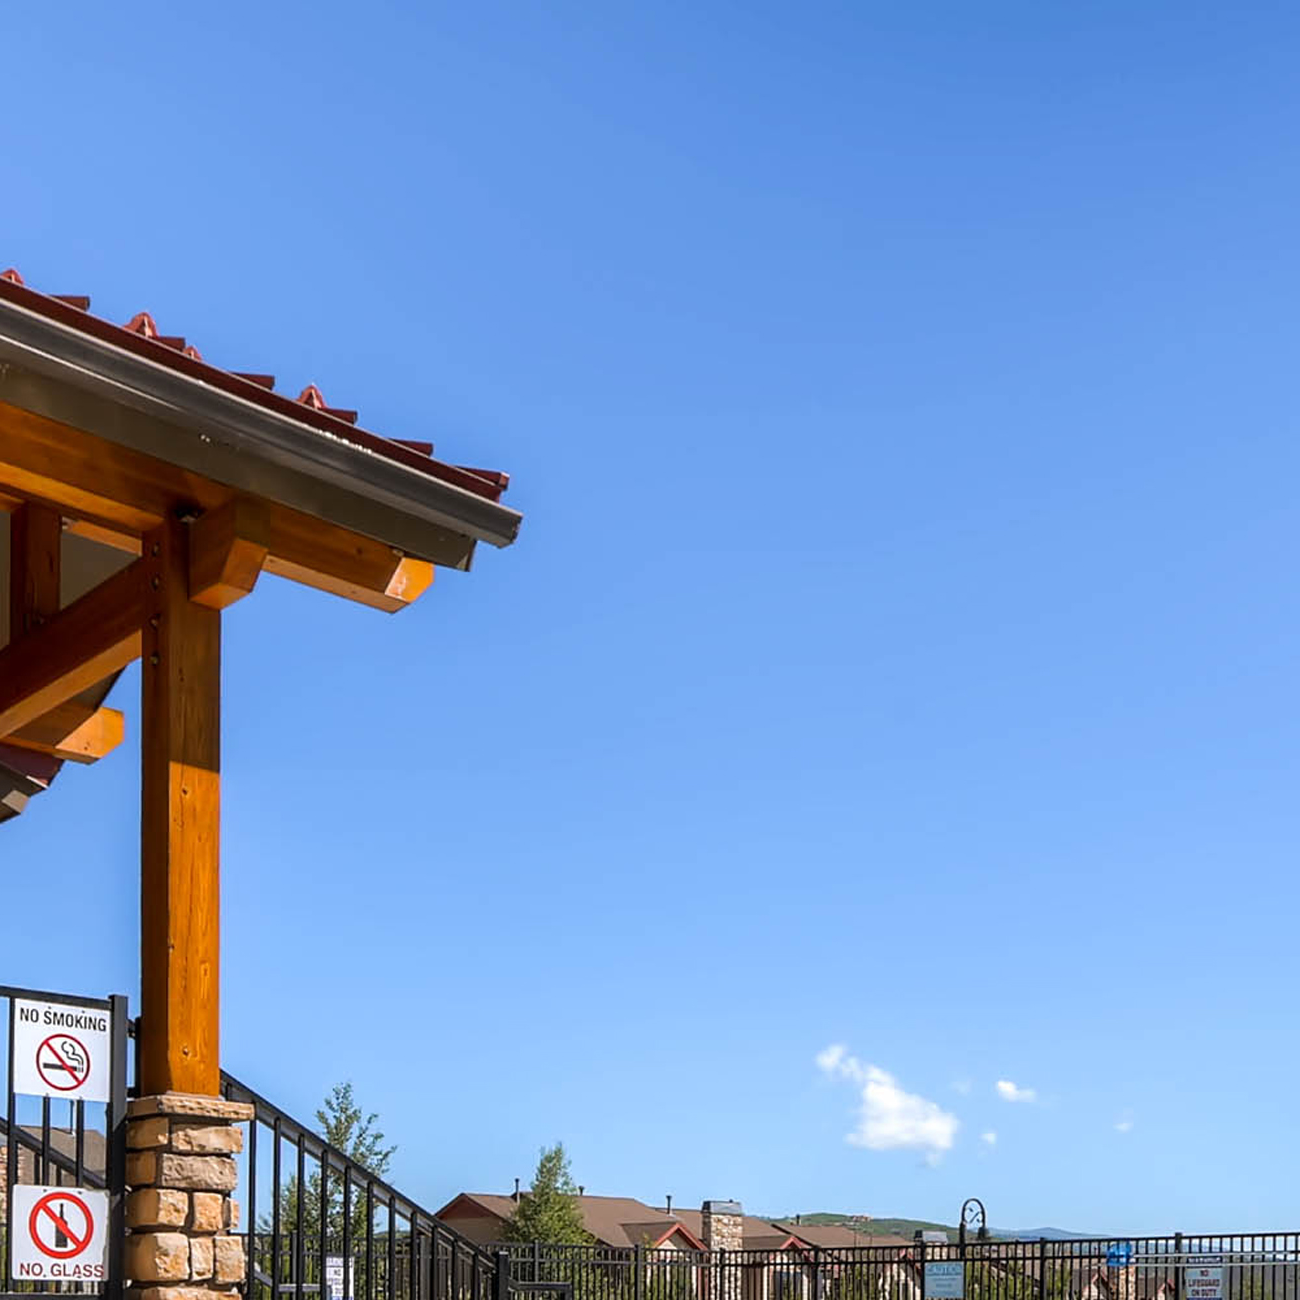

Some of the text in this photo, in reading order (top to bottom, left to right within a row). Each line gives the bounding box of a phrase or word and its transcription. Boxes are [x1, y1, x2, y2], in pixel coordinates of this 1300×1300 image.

[20, 1007, 107, 1032] NO SMOKING
[19, 1263, 104, 1278] NO GLASS
